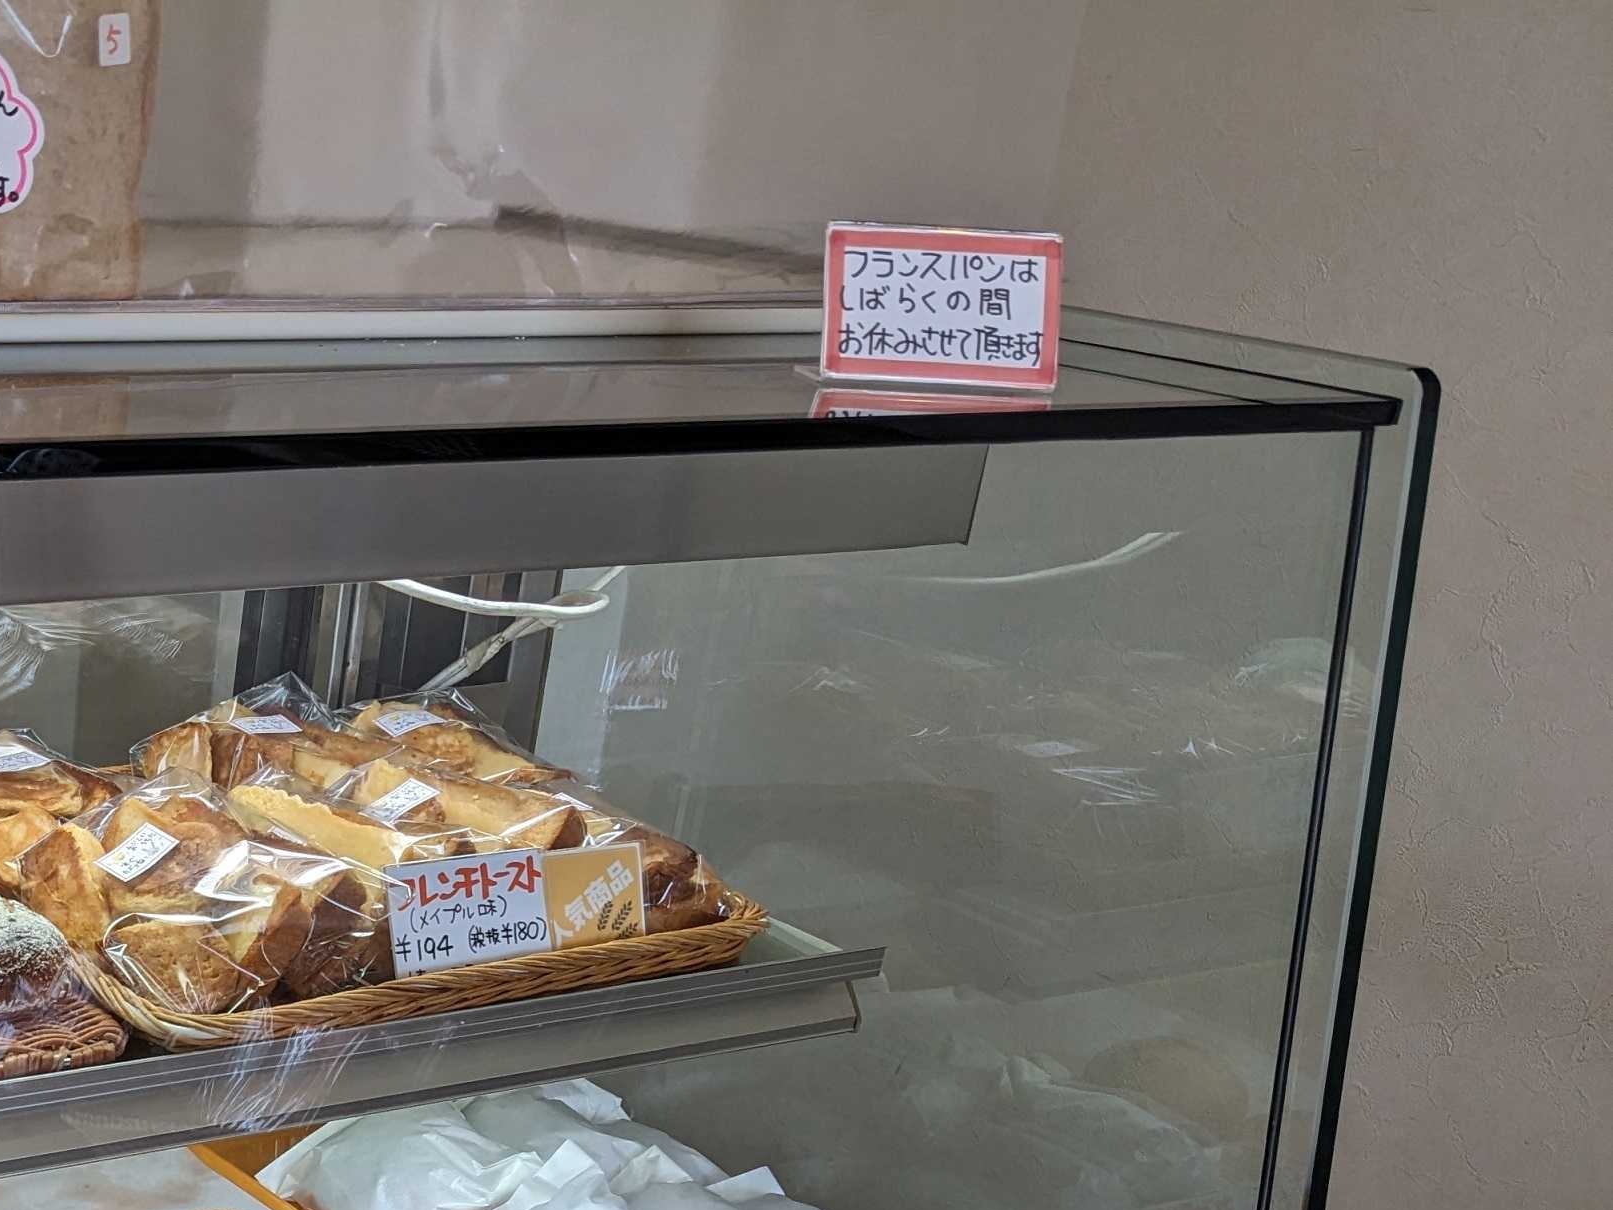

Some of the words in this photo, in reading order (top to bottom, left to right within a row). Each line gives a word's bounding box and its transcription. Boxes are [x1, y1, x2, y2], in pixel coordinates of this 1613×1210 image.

[106, 25, 122, 56] 5
[844, 250, 1039, 283] フランスパンは
[840, 284, 1012, 320] しばらくの間
[838, 322, 1044, 367] お休みさせて頂きます
[398, 855, 541, 911] フレンチトースト
[410, 896, 507, 933] (メイプル味)
[554, 859, 635, 948] 人気商品
[395, 934, 453, 963] ¥194
